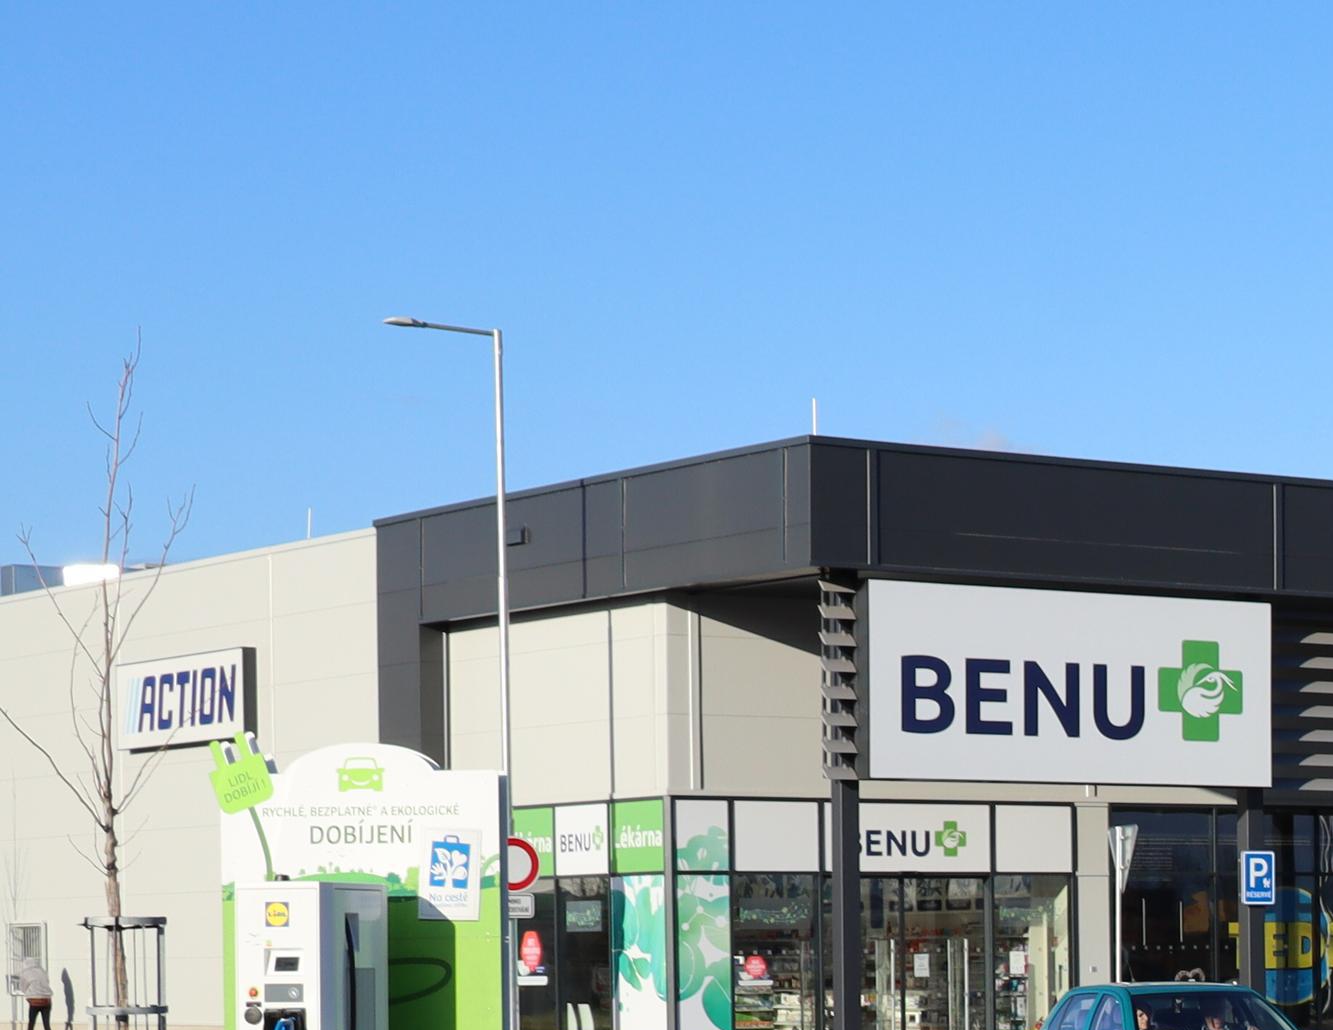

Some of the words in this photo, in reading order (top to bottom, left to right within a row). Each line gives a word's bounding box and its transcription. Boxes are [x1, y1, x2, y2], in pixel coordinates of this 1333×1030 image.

[138, 664, 236, 733] ACTION
[901, 654, 1145, 741] BENU
[228, 771, 253, 788] LIDL
[380, 806, 388, 816] A
[391, 803, 460, 816] EKOLOGICKÉ
[309, 818, 414, 845] DOBÍJENÍ
[560, 832, 591, 853] BENU
[859, 829, 931, 857] ENU
[1250, 858, 1269, 888] P
